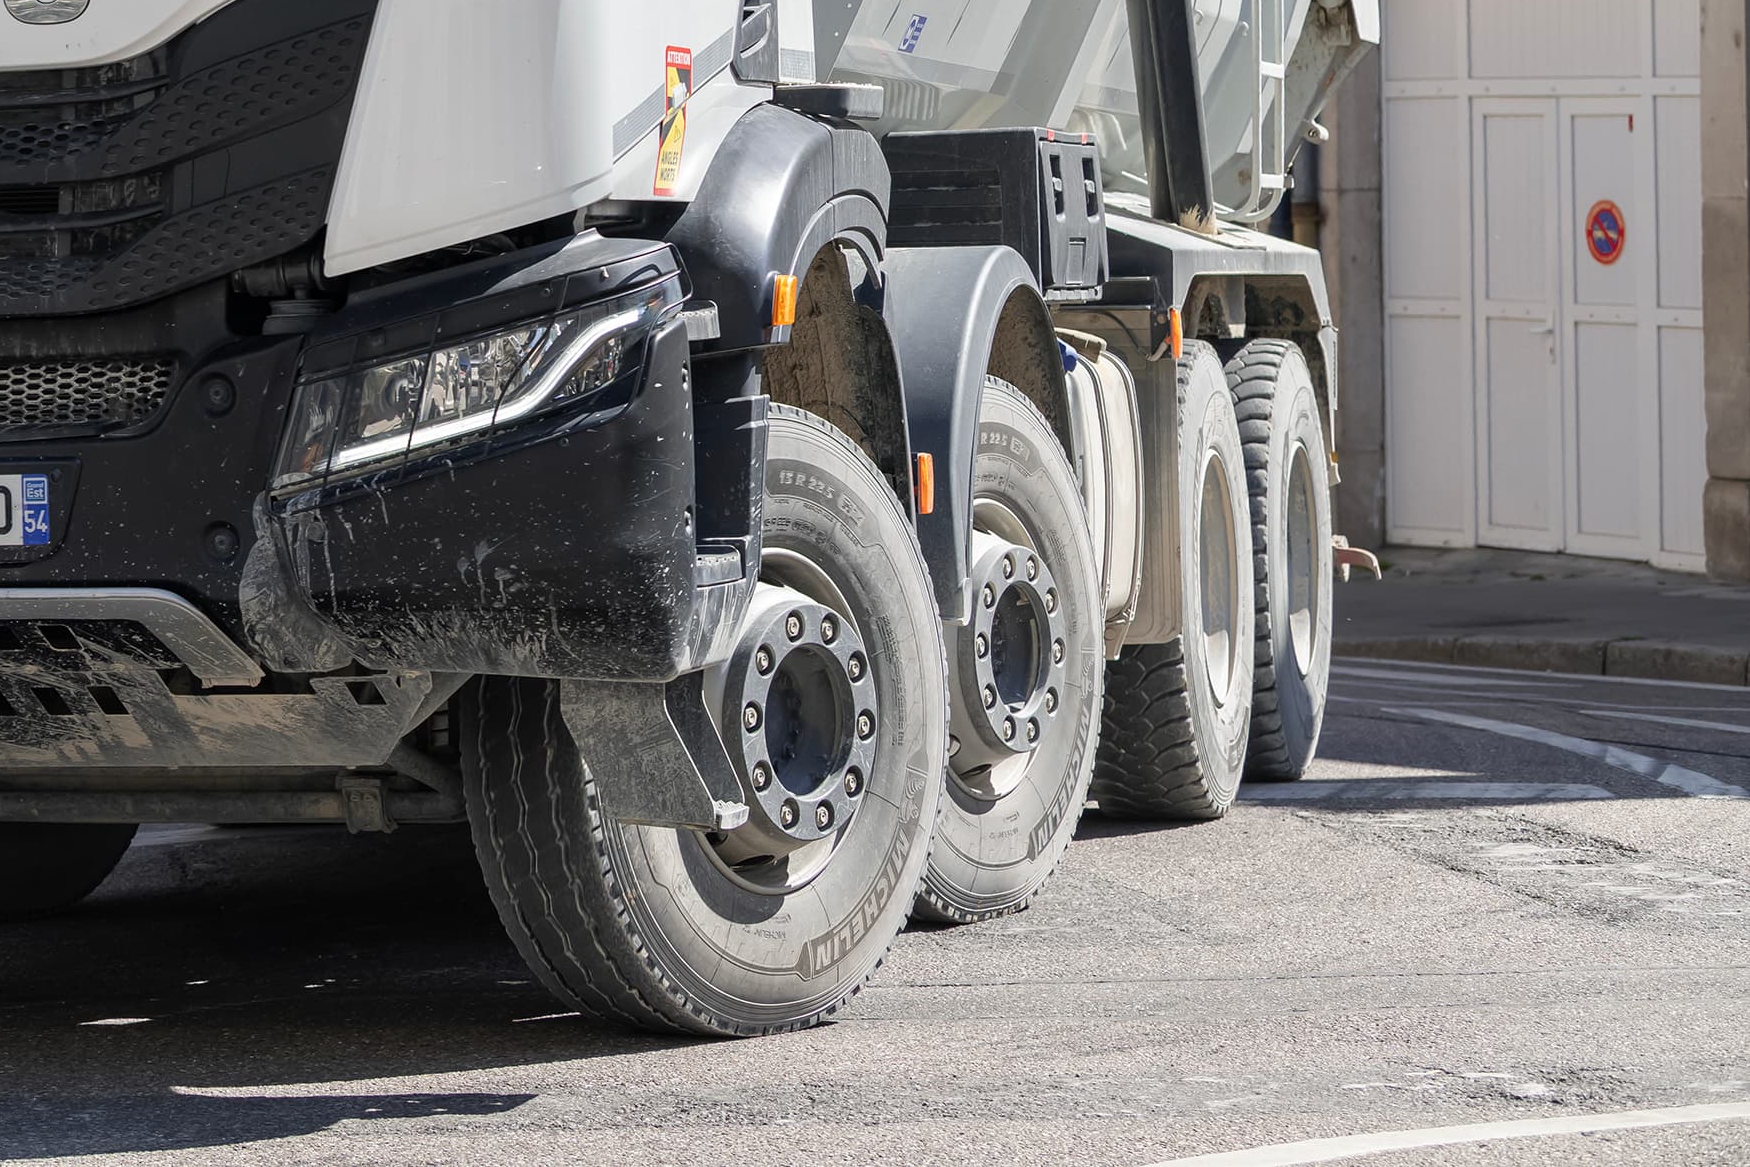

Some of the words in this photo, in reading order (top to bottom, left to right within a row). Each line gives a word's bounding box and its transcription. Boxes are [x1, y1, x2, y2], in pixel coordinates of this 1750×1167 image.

[24, 509, 48, 533] 54
[26, 488, 44, 498] Est
[1036, 704, 1090, 852] MICHELIN
[815, 825, 913, 971] MICHELIN
